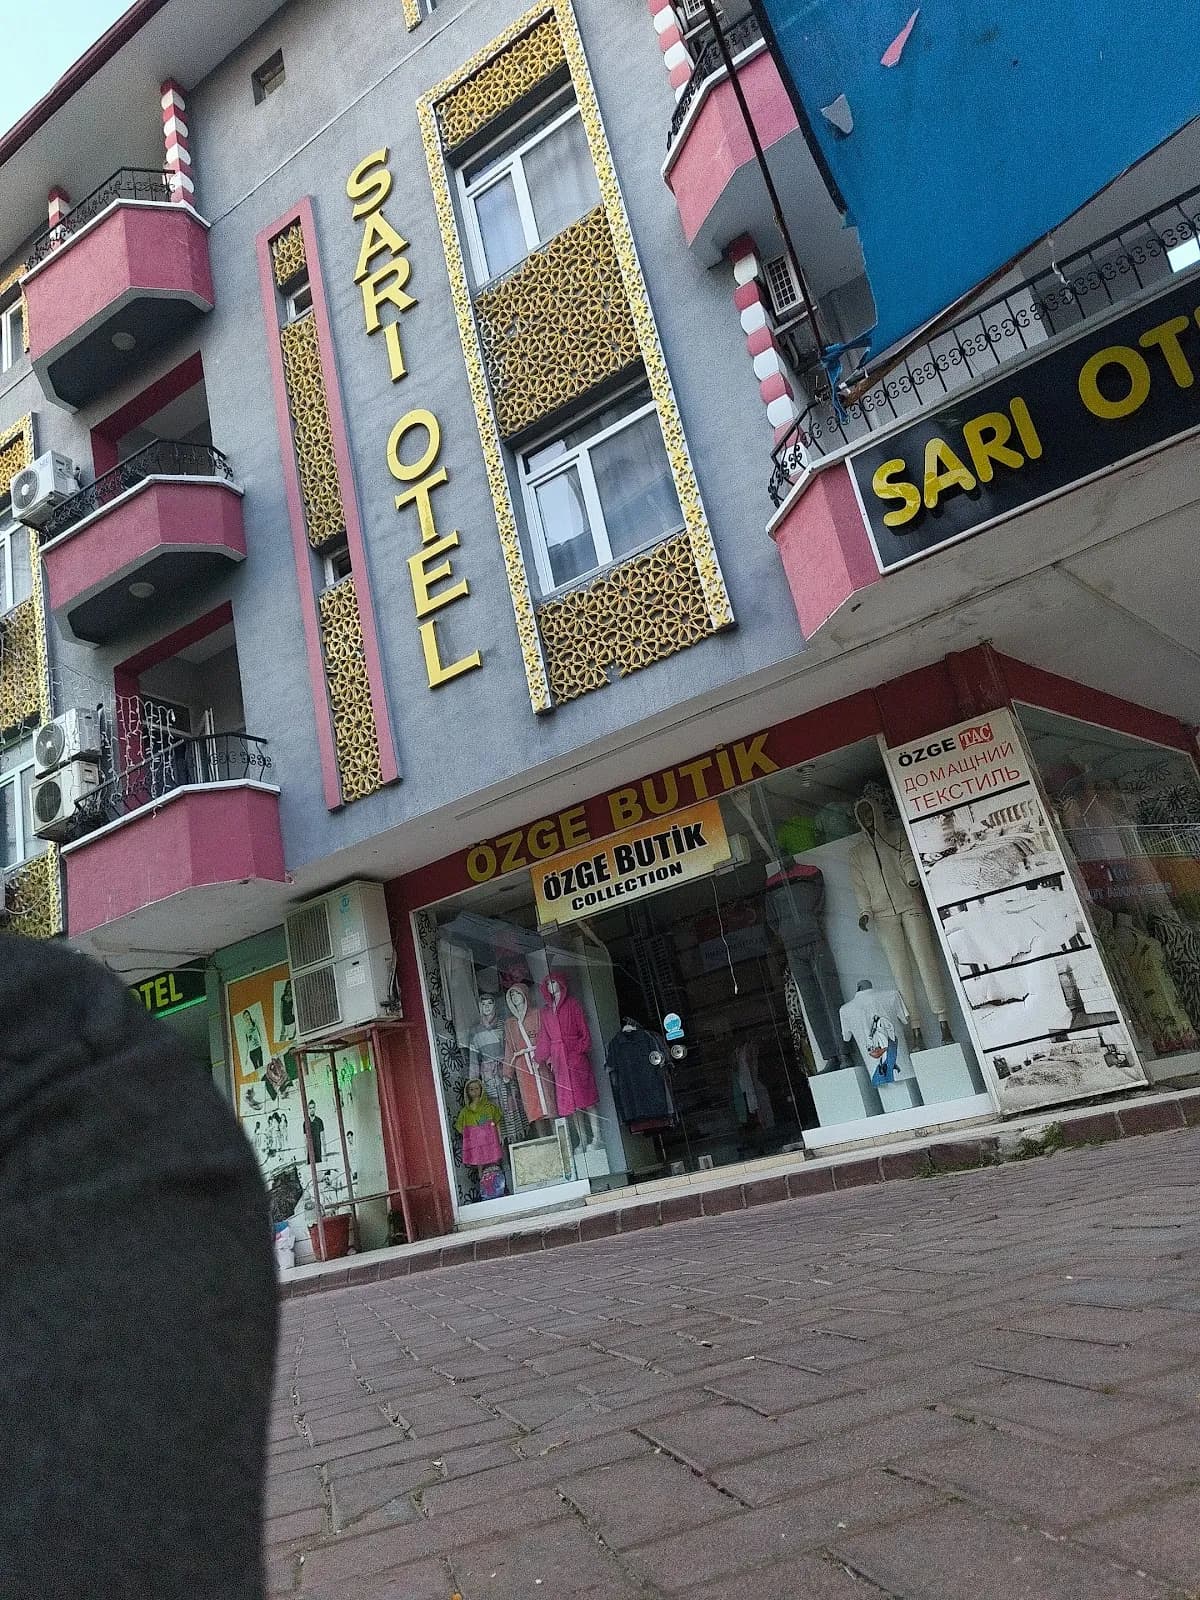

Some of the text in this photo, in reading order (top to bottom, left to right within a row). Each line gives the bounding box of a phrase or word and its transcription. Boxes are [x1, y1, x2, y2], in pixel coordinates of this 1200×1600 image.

[346, 145, 482, 689] SARI OTEL
[872, 305, 1200, 527] SARI OT
[899, 737, 957, 768] ÖZGE
[904, 740, 1015, 795] ДОМАЩНИЙ
[466, 732, 783, 883] ÖZGE BUTİK
[910, 765, 1021, 812] ТЕКСТИЛЬ
[542, 821, 708, 901] ÖZGE BUTİK
[572, 861, 683, 911] COLLECTION
